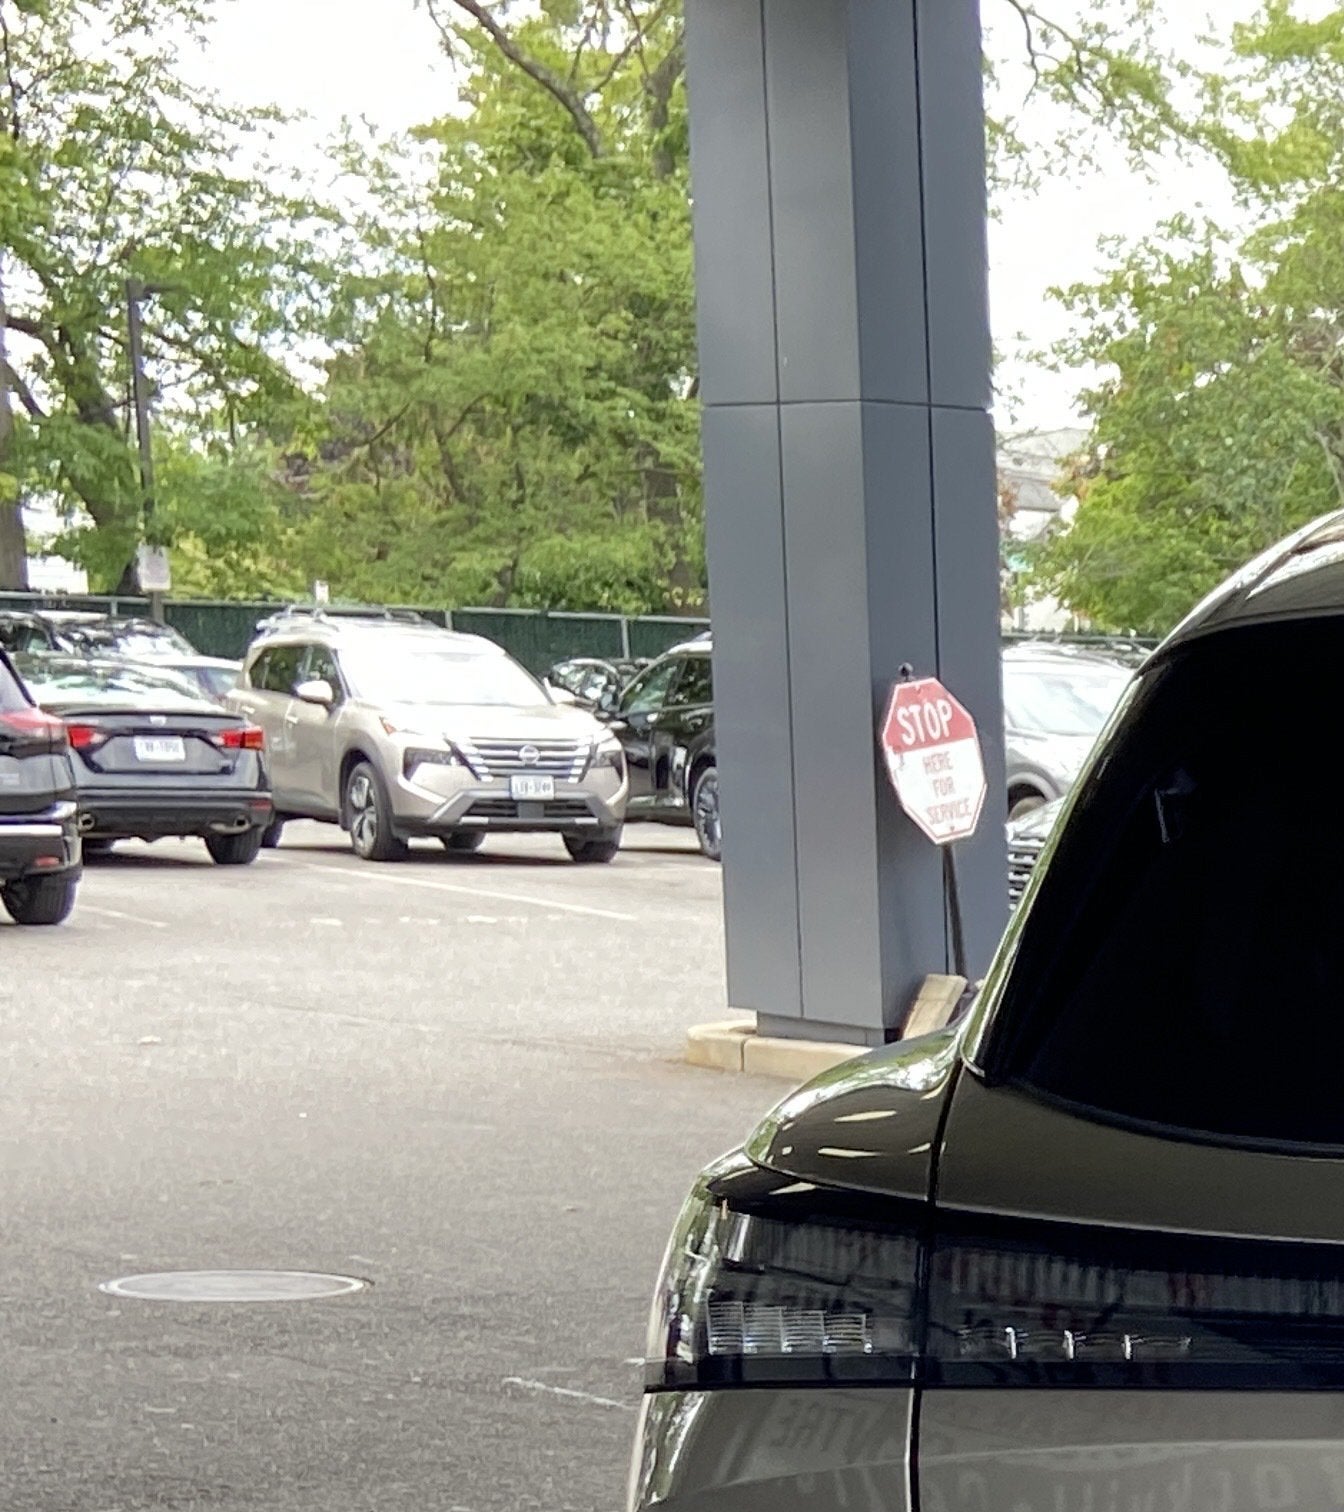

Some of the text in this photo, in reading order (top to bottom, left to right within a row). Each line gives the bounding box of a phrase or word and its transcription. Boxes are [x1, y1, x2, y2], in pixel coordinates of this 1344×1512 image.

[897, 701, 953, 745] STOP
[923, 752, 953, 774] HERE
[933, 777, 955, 798] FOR
[927, 799, 972, 824] SERVICE
